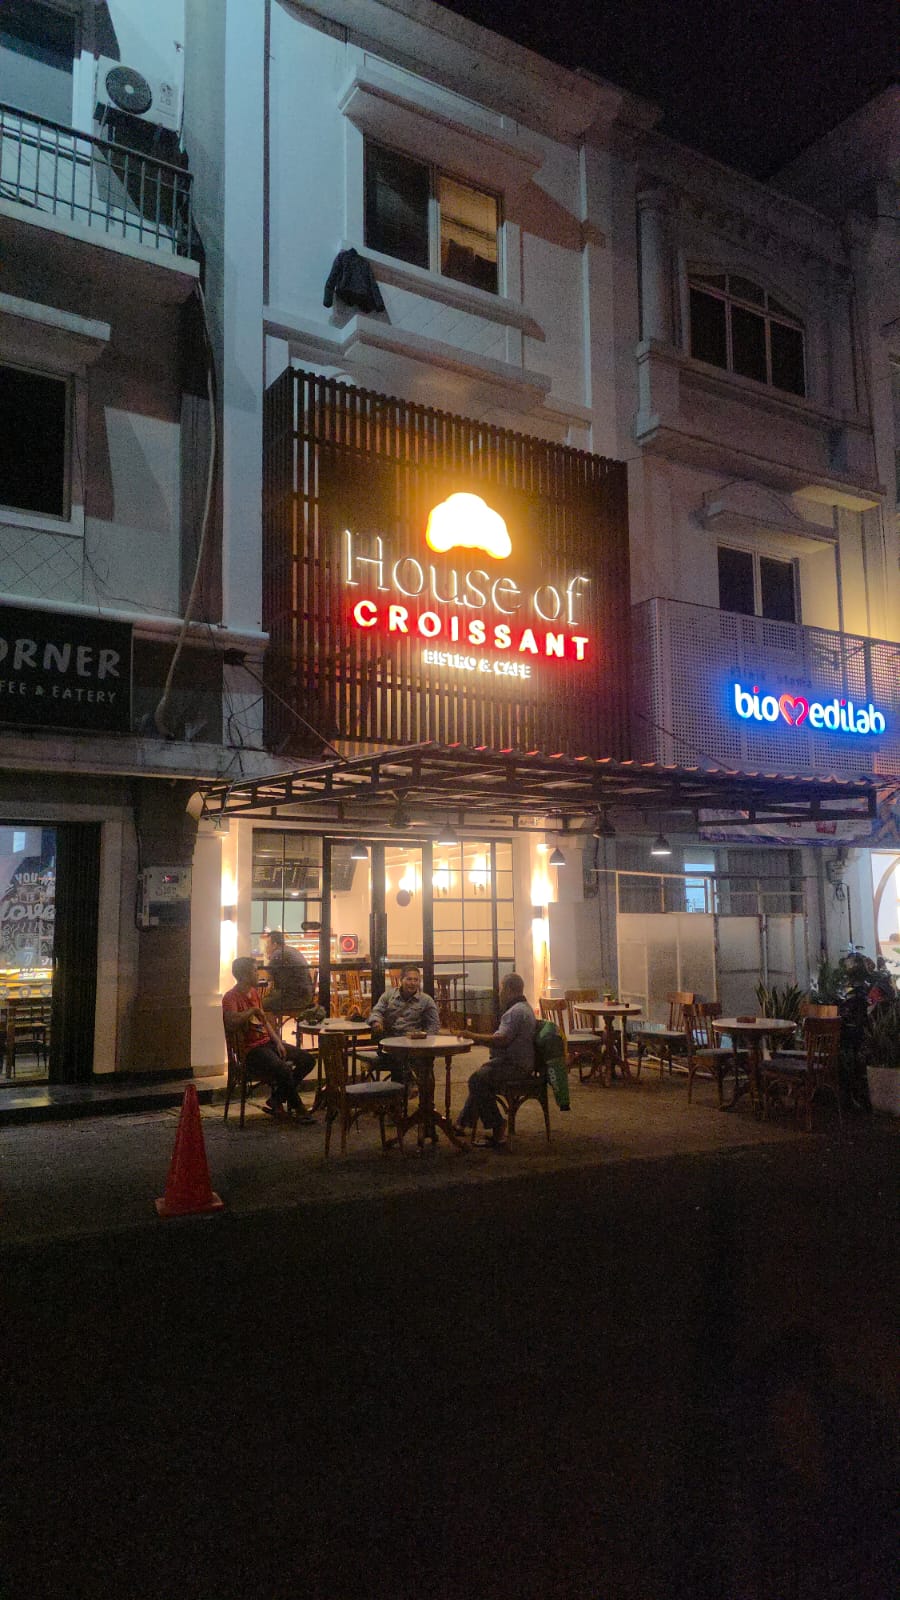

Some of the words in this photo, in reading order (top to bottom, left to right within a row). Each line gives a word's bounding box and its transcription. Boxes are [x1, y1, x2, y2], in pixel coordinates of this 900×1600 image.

[345, 530, 522, 614] House
[533, 574, 590, 625] of
[353, 600, 589, 661] CROISSANT
[423, 649, 477, 671] BISTRO
[479, 658, 493, 673] &
[494, 660, 532, 679] CAFE
[52, 685, 117, 704] EATERY
